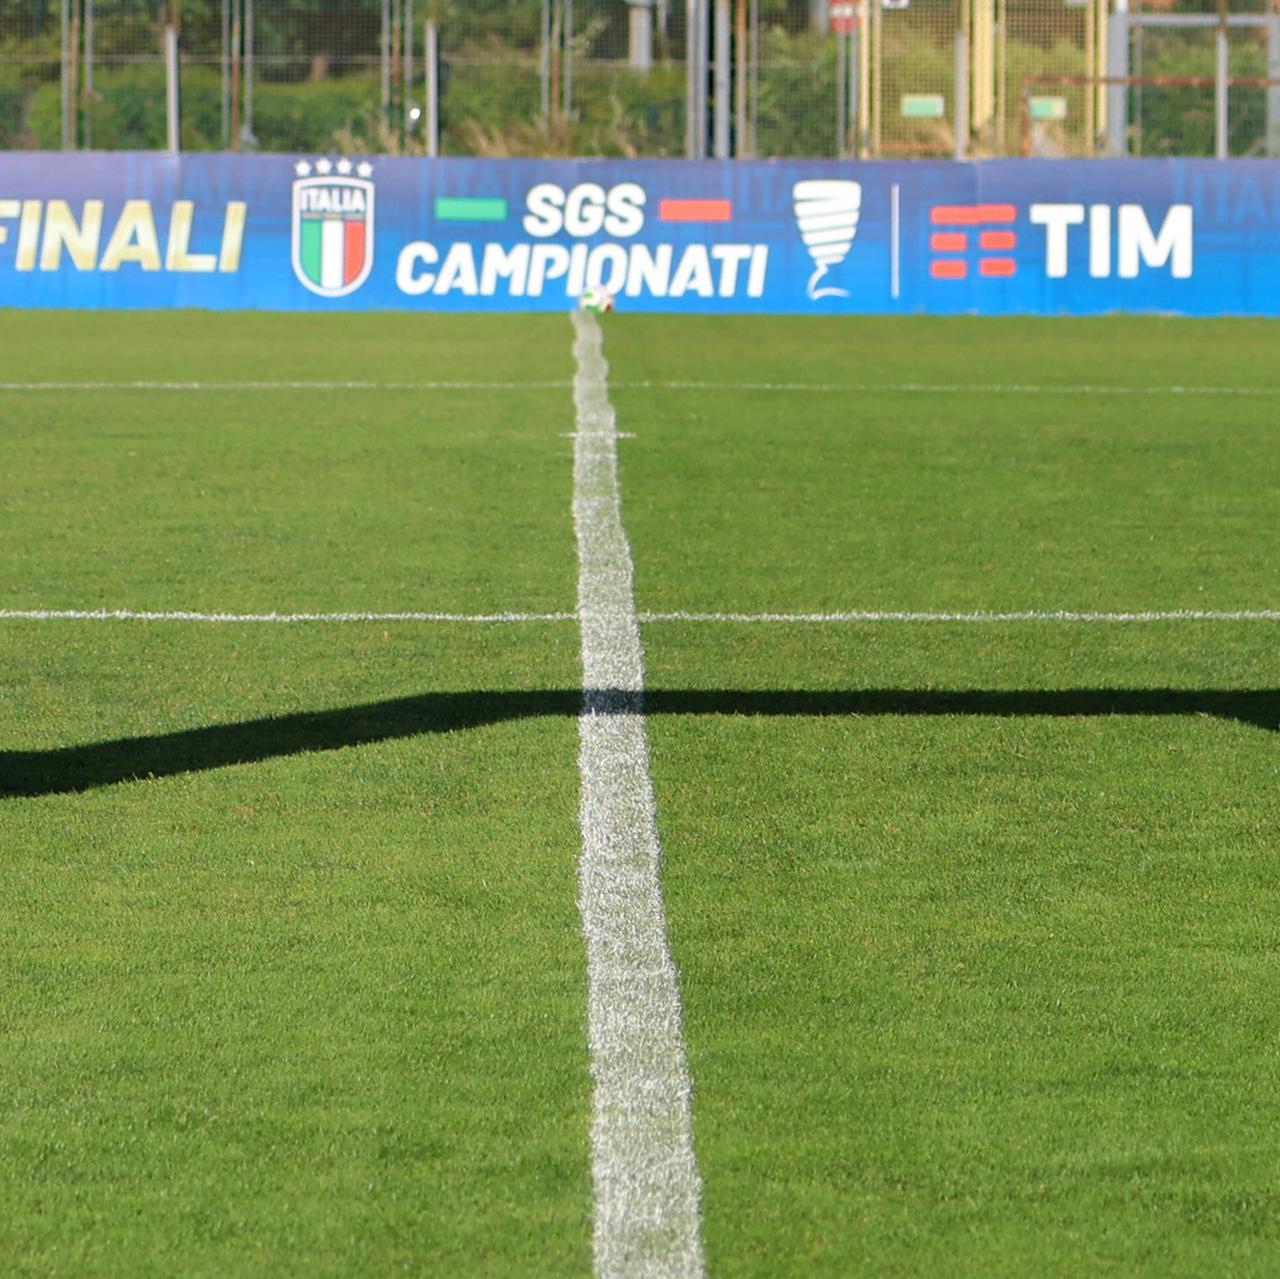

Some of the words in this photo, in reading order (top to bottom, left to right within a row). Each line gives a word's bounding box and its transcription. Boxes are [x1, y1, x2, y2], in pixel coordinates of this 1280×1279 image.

[300, 188, 366, 213] ITALIA
[523, 183, 648, 237] SGS
[1030, 204, 1193, 278] TIM
[395, 241, 769, 297] CAMPIONATI
